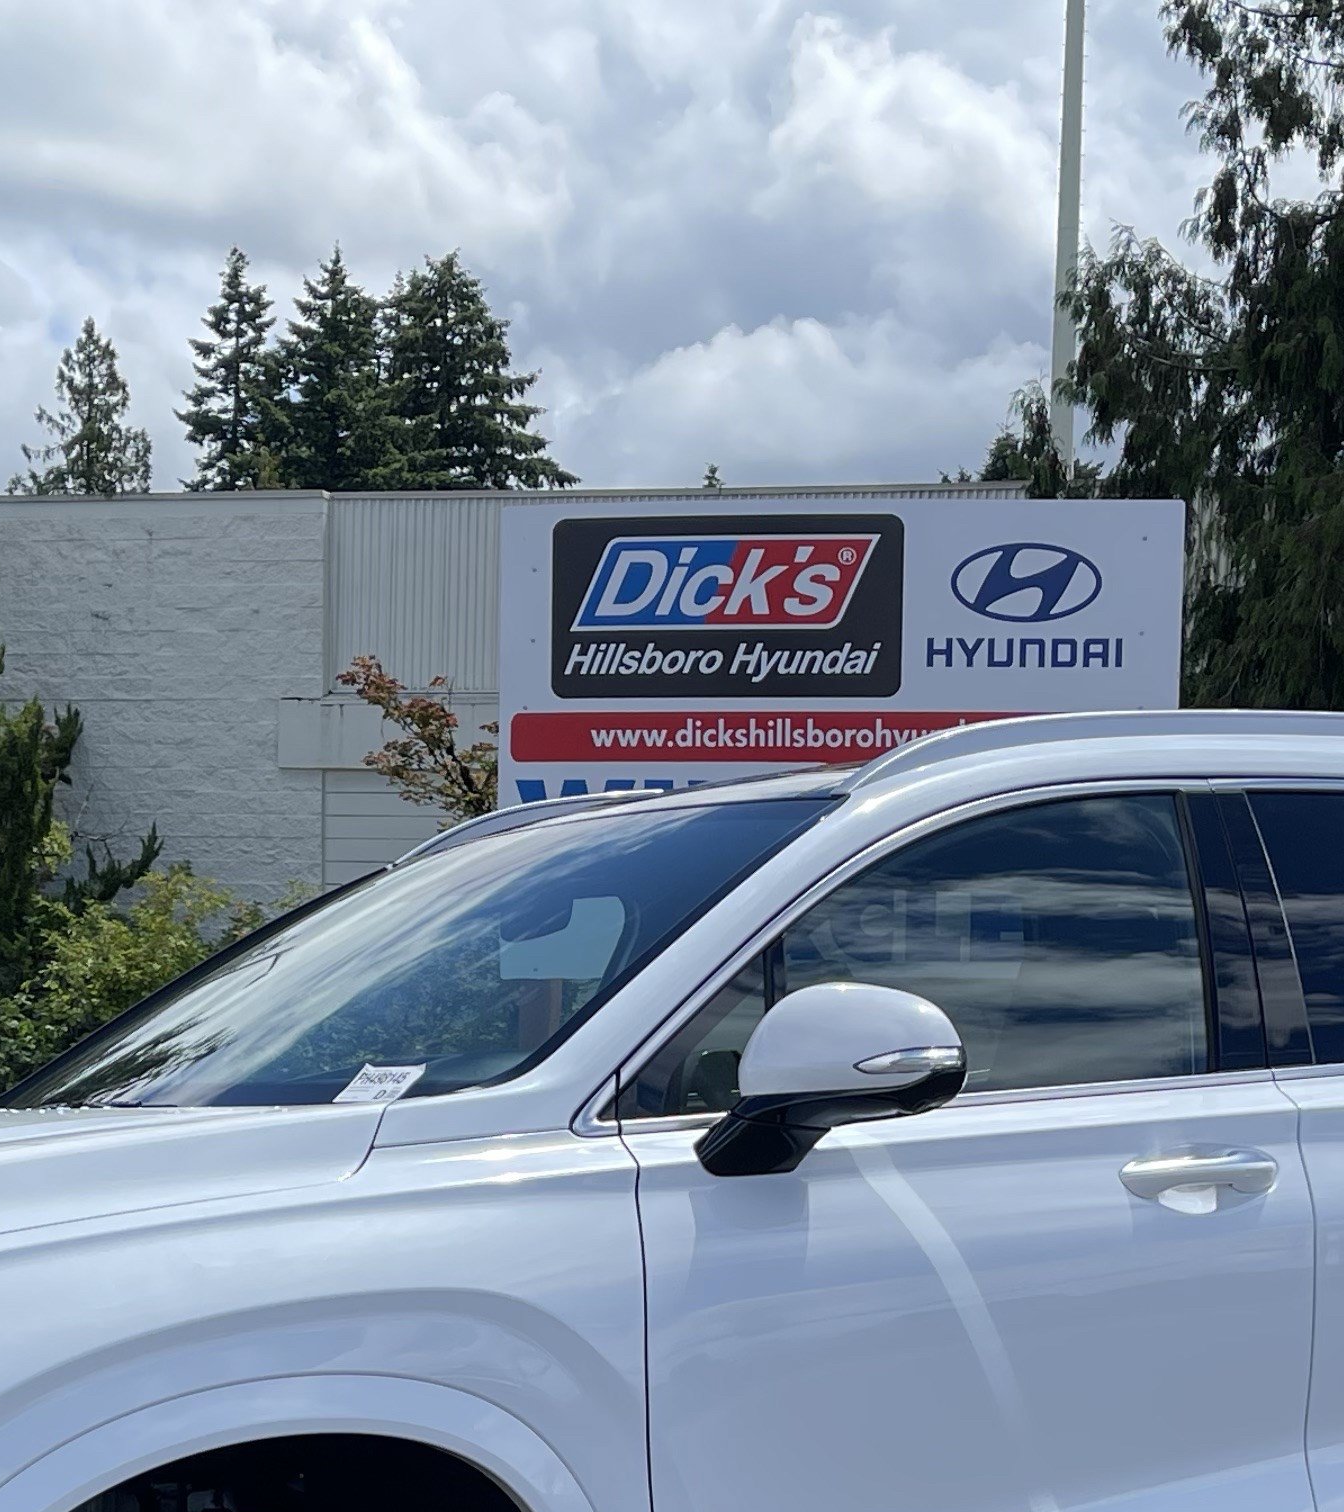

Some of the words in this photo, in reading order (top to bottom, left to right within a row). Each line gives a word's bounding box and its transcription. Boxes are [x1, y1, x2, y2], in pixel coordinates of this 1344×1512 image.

[564, 642, 723, 676] Hillsboro
[729, 642, 882, 682] Hyundai
[926, 637, 1123, 668] HYUNDAI
